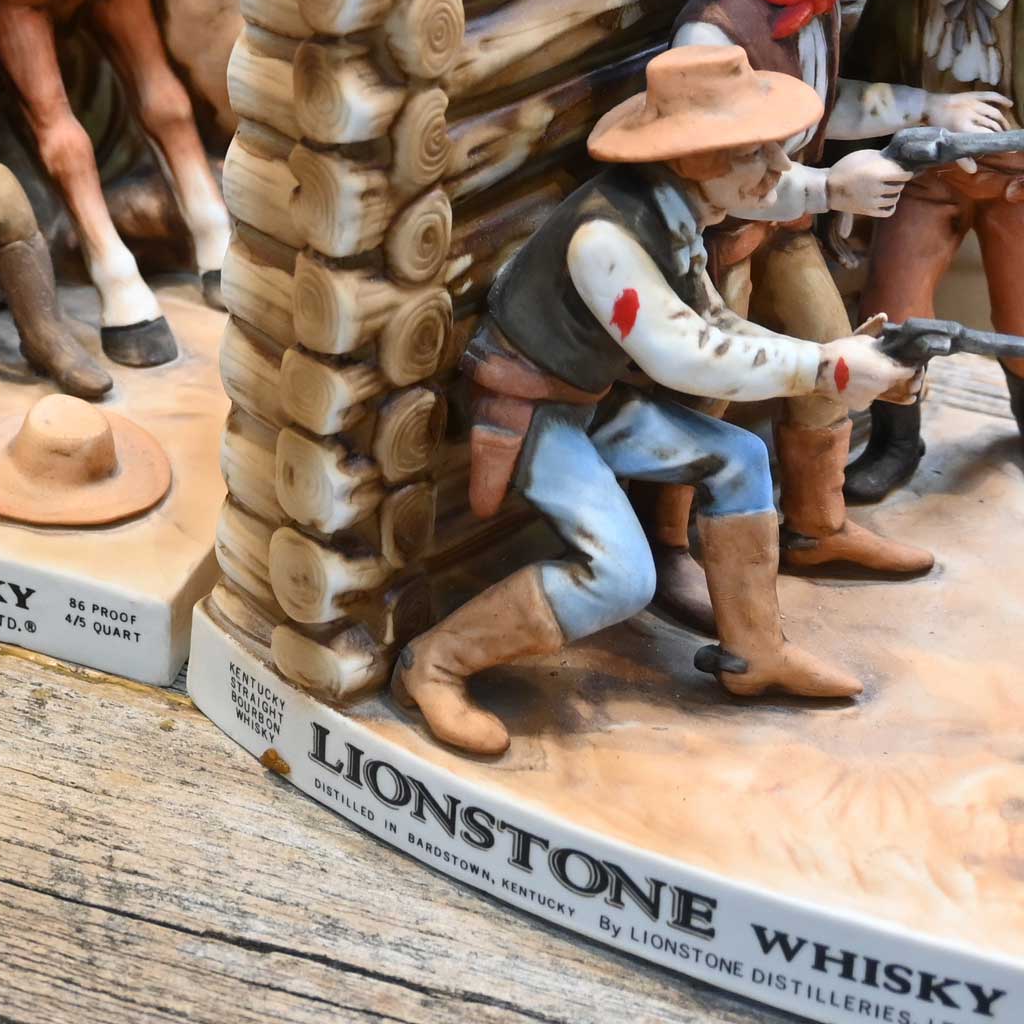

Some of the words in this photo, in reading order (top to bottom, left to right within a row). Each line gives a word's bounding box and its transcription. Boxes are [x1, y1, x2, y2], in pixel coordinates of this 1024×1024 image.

[65, 613, 87, 628] 4/5
[93, 621, 142, 643] QUART
[69, 597, 86, 611] 86
[92, 604, 138, 625] PROOF
[229, 661, 286, 711] KENTUCKY
[230, 679, 284, 724] STRAIGHT
[231, 692, 281, 735] BOURBON
[235, 710, 276, 744] WHISKY
[308, 721, 718, 940] LIONSTONE
[750, 923, 1006, 1017] WHISKY
[314, 778, 376, 822] DISTILLED
[384, 819, 398, 834] IN
[501, 878, 576, 917] KENTUCKY
[599, 914, 623, 938] By
[630, 926, 744, 978] LIONSTONE
[751, 967, 916, 1024] DISTILLERIES
